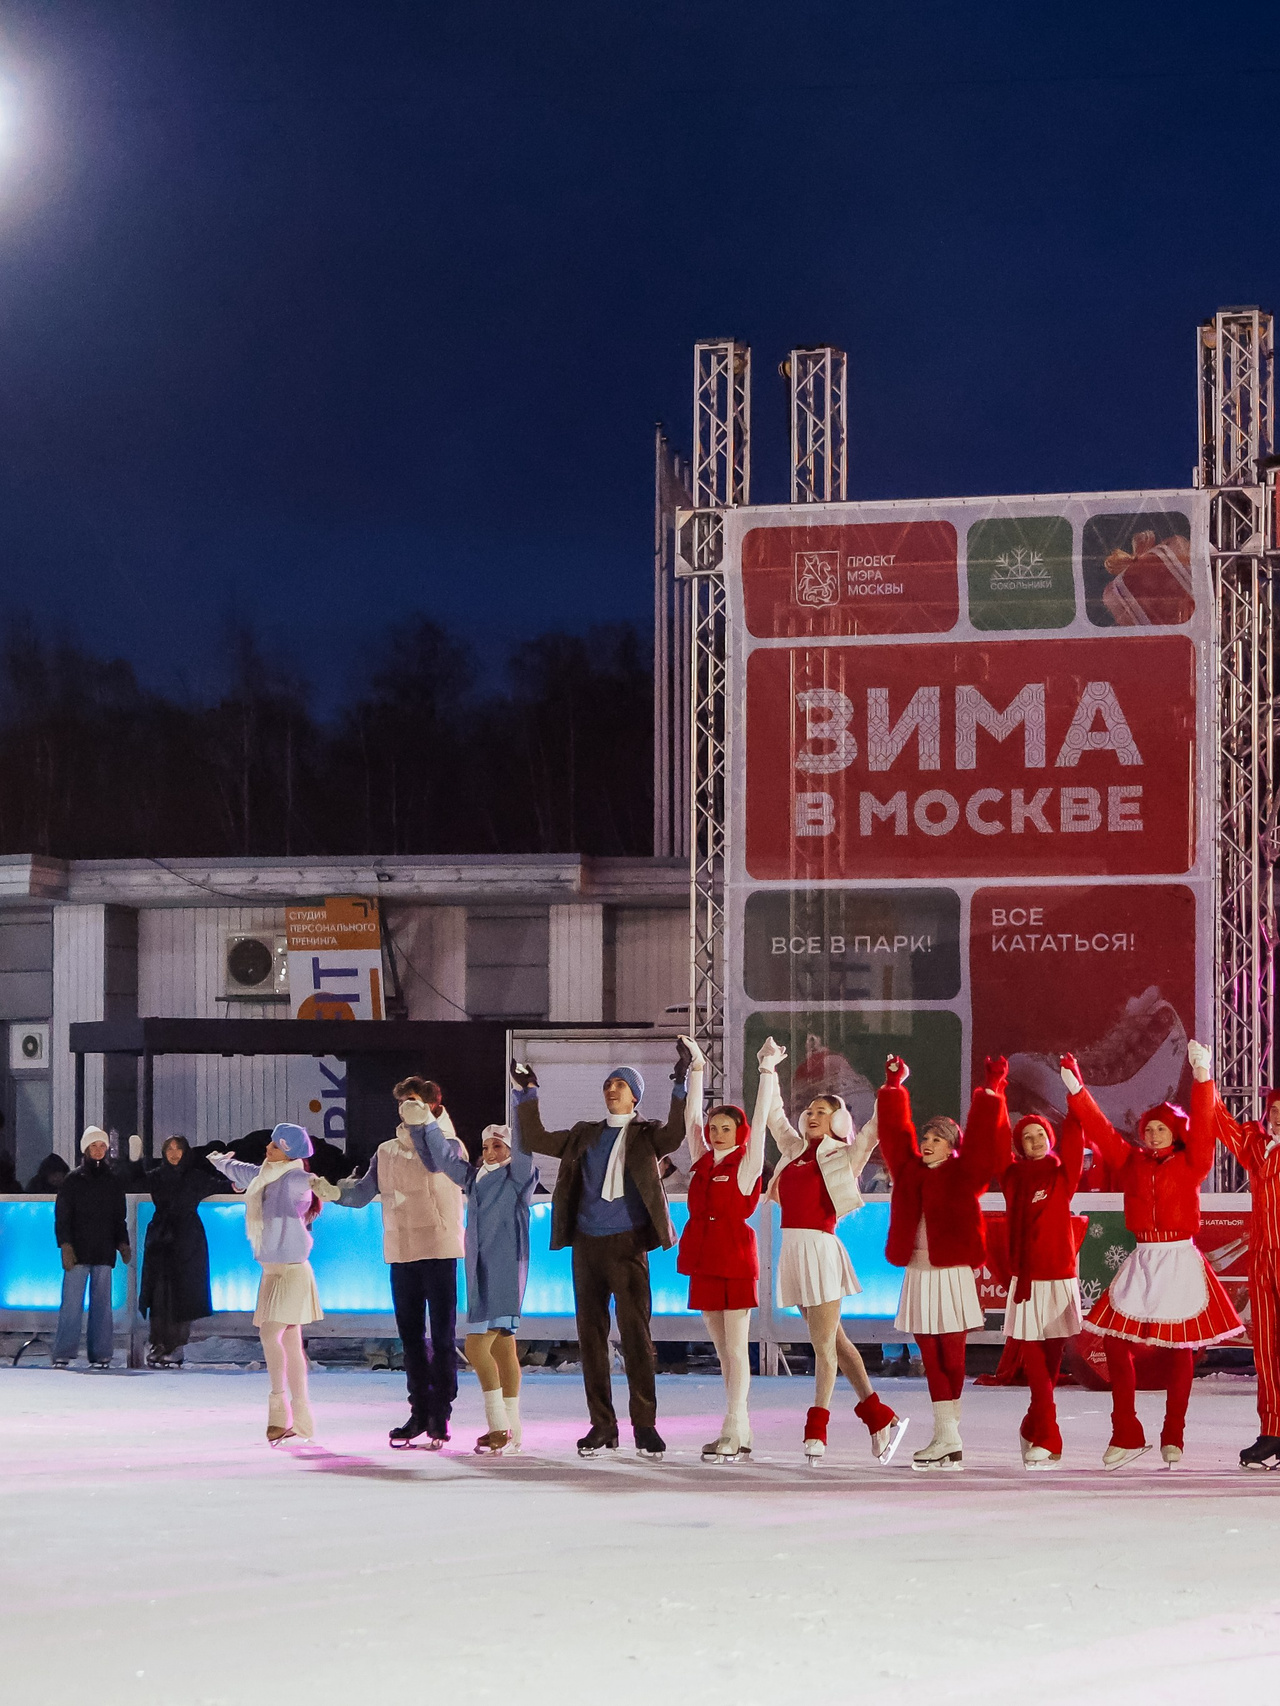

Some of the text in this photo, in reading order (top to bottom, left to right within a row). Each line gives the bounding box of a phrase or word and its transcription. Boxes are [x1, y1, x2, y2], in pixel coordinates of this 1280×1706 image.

[847, 554, 896, 568] ПРОЕКТ
[847, 569, 883, 582] МЭРА
[847, 583, 904, 596] МОСКВЫ
[990, 580, 1052, 590] СОКОЛЬНИКИ
[794, 681, 1144, 774] ЗИМА
[795, 785, 1144, 837] В МОСКВЕ
[289, 911, 327, 921] СТУДИЯ
[991, 907, 1044, 927] ВСЕ
[289, 922, 376, 933] ПЕРСОНАЛЬНОГО
[291, 936, 338, 946] ТРЕНИНГА
[771, 935, 932, 954] ВСЕ В ПАРК!
[991, 932, 1136, 952] КАТАТЬСЯ!
